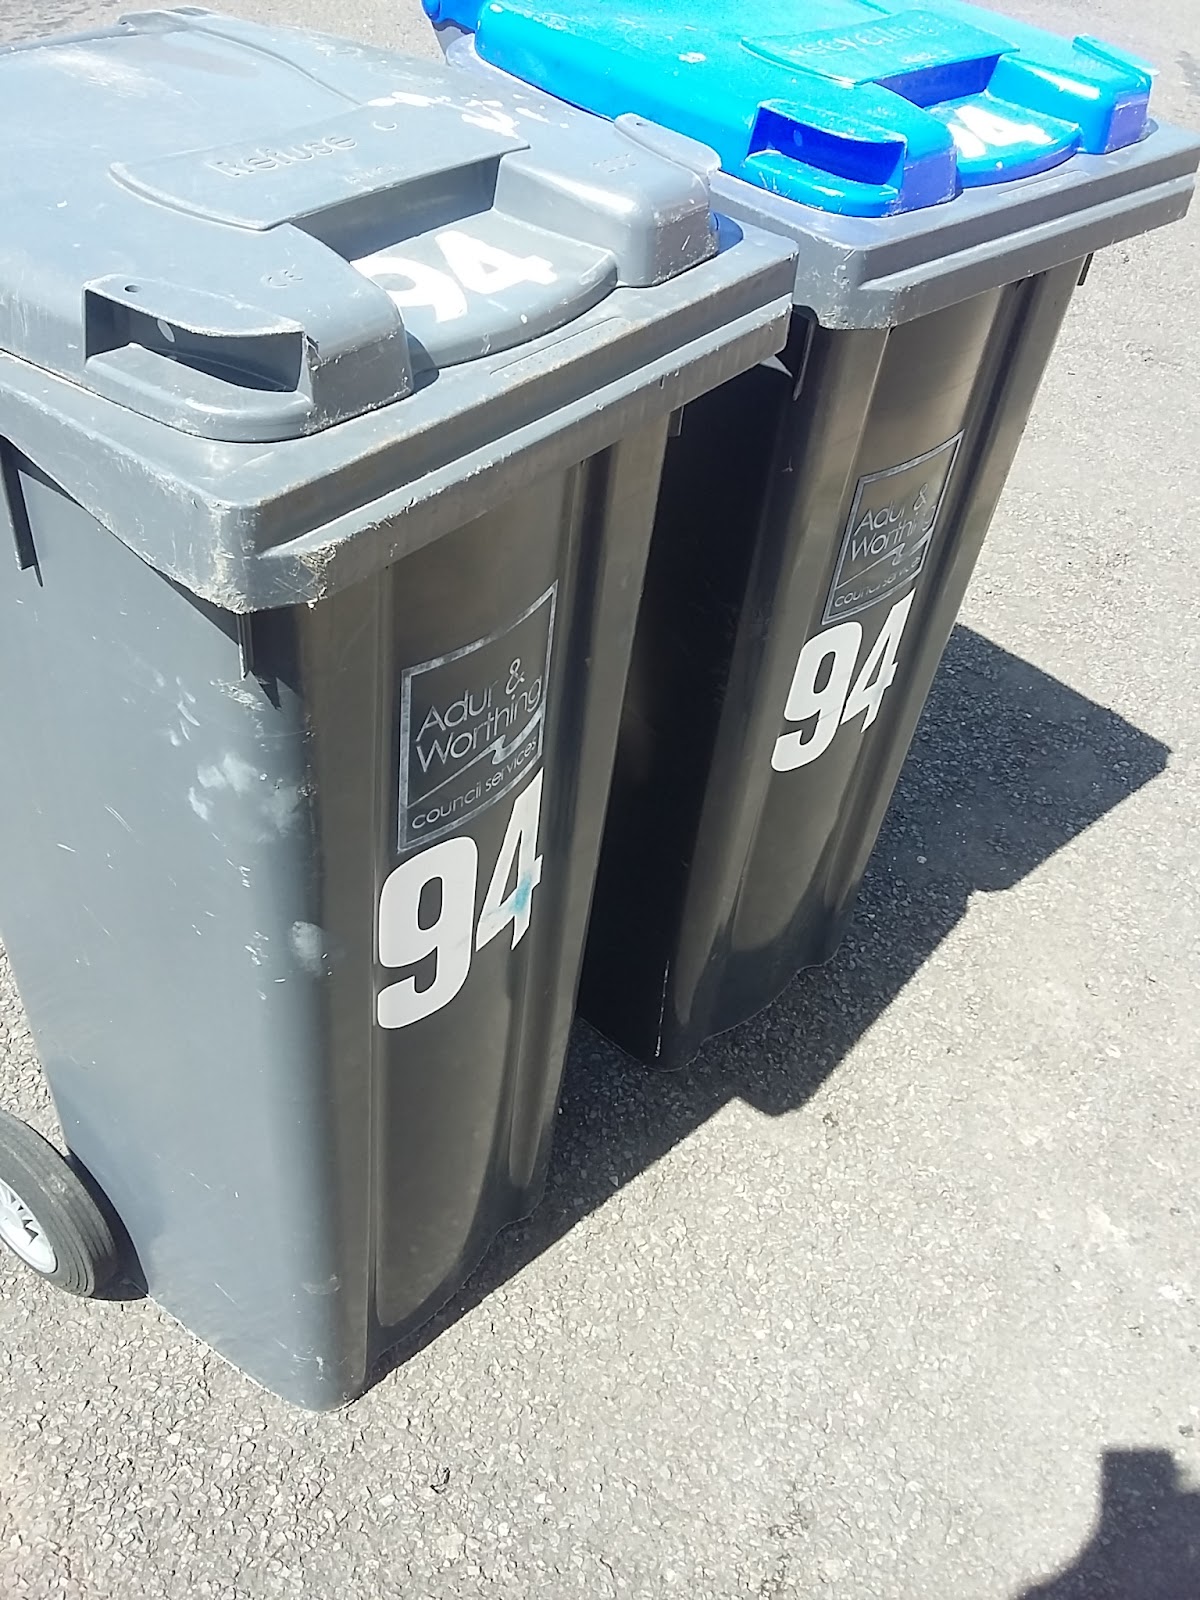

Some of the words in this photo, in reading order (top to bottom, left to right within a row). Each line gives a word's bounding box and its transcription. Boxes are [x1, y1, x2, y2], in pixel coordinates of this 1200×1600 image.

[203, 136, 358, 178] Refuse
[350, 230, 557, 323] 94
[851, 504, 936, 562] Worthig
[913, 483, 928, 511] &
[415, 679, 499, 743] Adur
[505, 657, 526, 696] &
[416, 675, 543, 773] Worthing
[771, 587, 916, 772] 94
[411, 782, 482, 830] council
[485, 735, 538, 793] services
[377, 766, 544, 1029] 94
